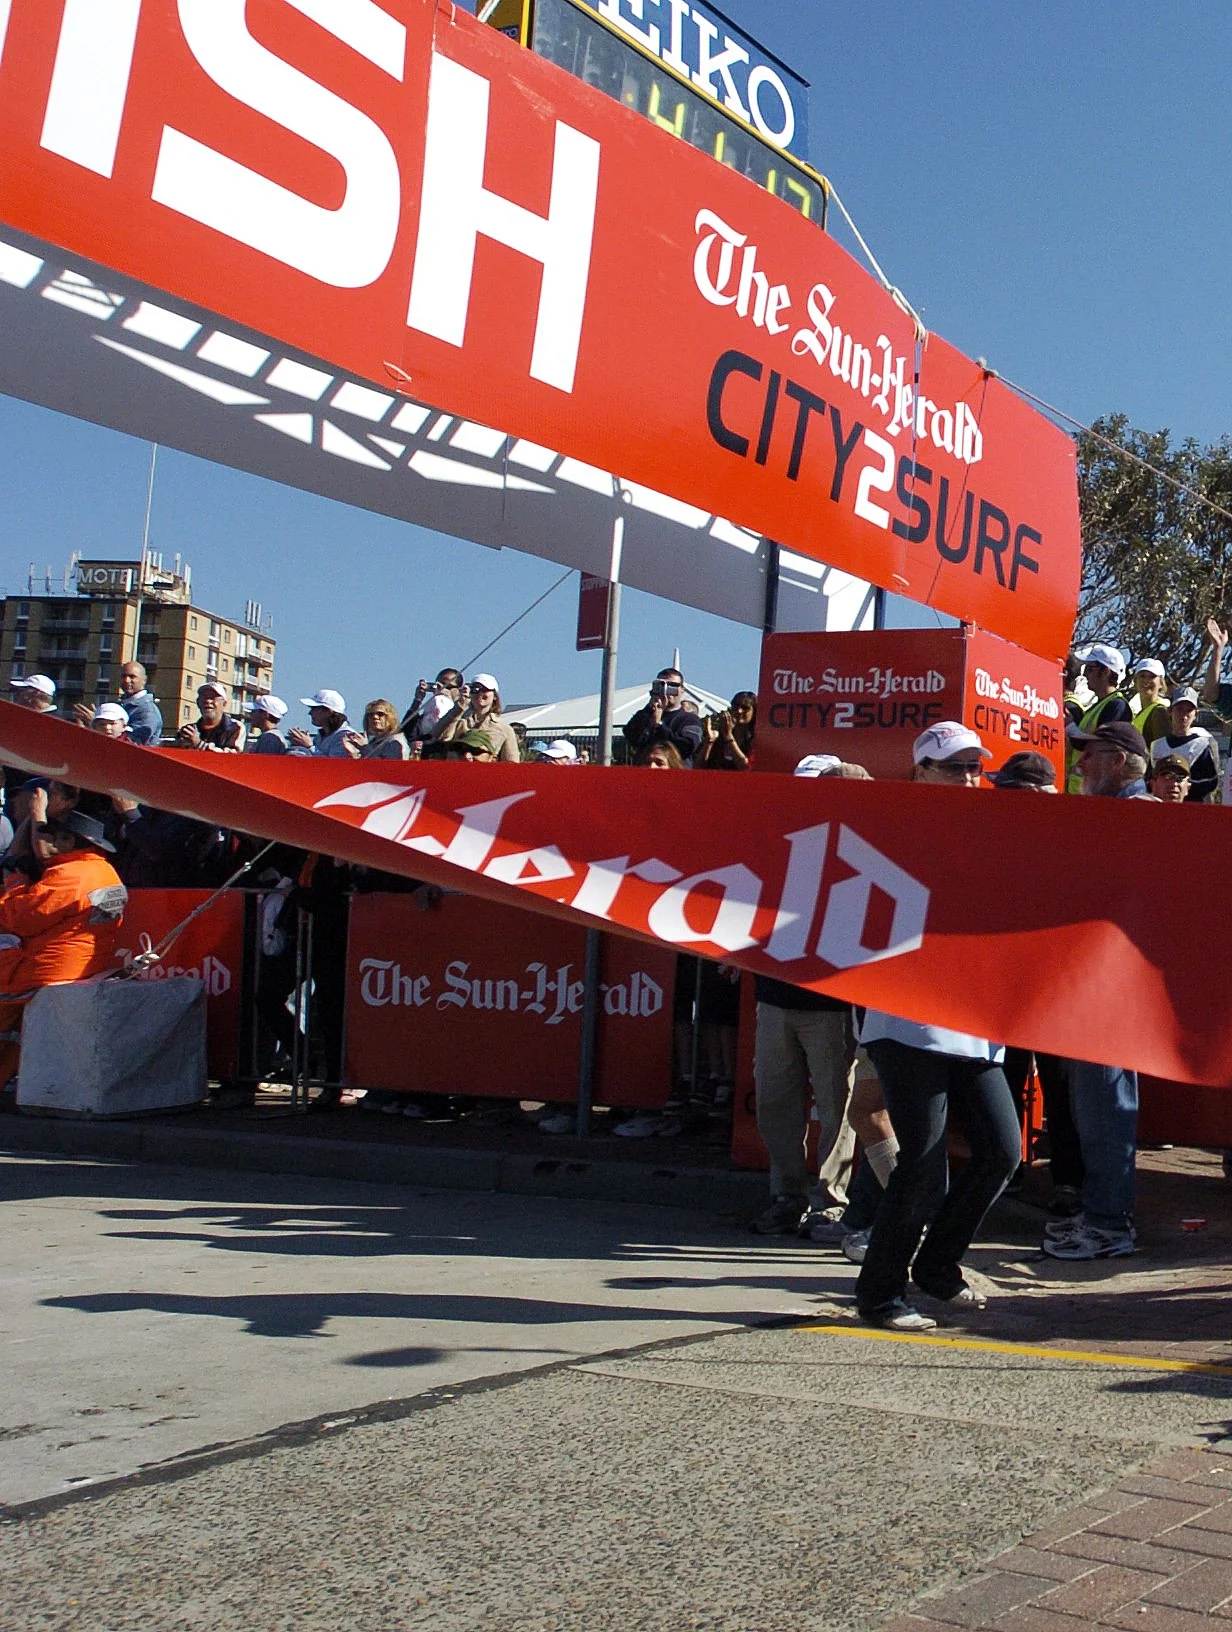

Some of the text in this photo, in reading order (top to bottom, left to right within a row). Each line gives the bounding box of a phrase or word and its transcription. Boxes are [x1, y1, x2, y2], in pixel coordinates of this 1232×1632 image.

[598, 0, 795, 149] EIKO
[0, 0, 600, 393] ISH
[694, 208, 983, 465] The Sun-Herald
[706, 349, 1043, 592] CITY2SURF
[769, 702, 943, 729] CITY2SURF
[773, 667, 946, 699] The Sun-Herald
[975, 668, 1059, 720] The Sun-Herald
[974, 704, 1059, 750] CITY2SURF
[359, 957, 664, 1025] The Sun-Heald
